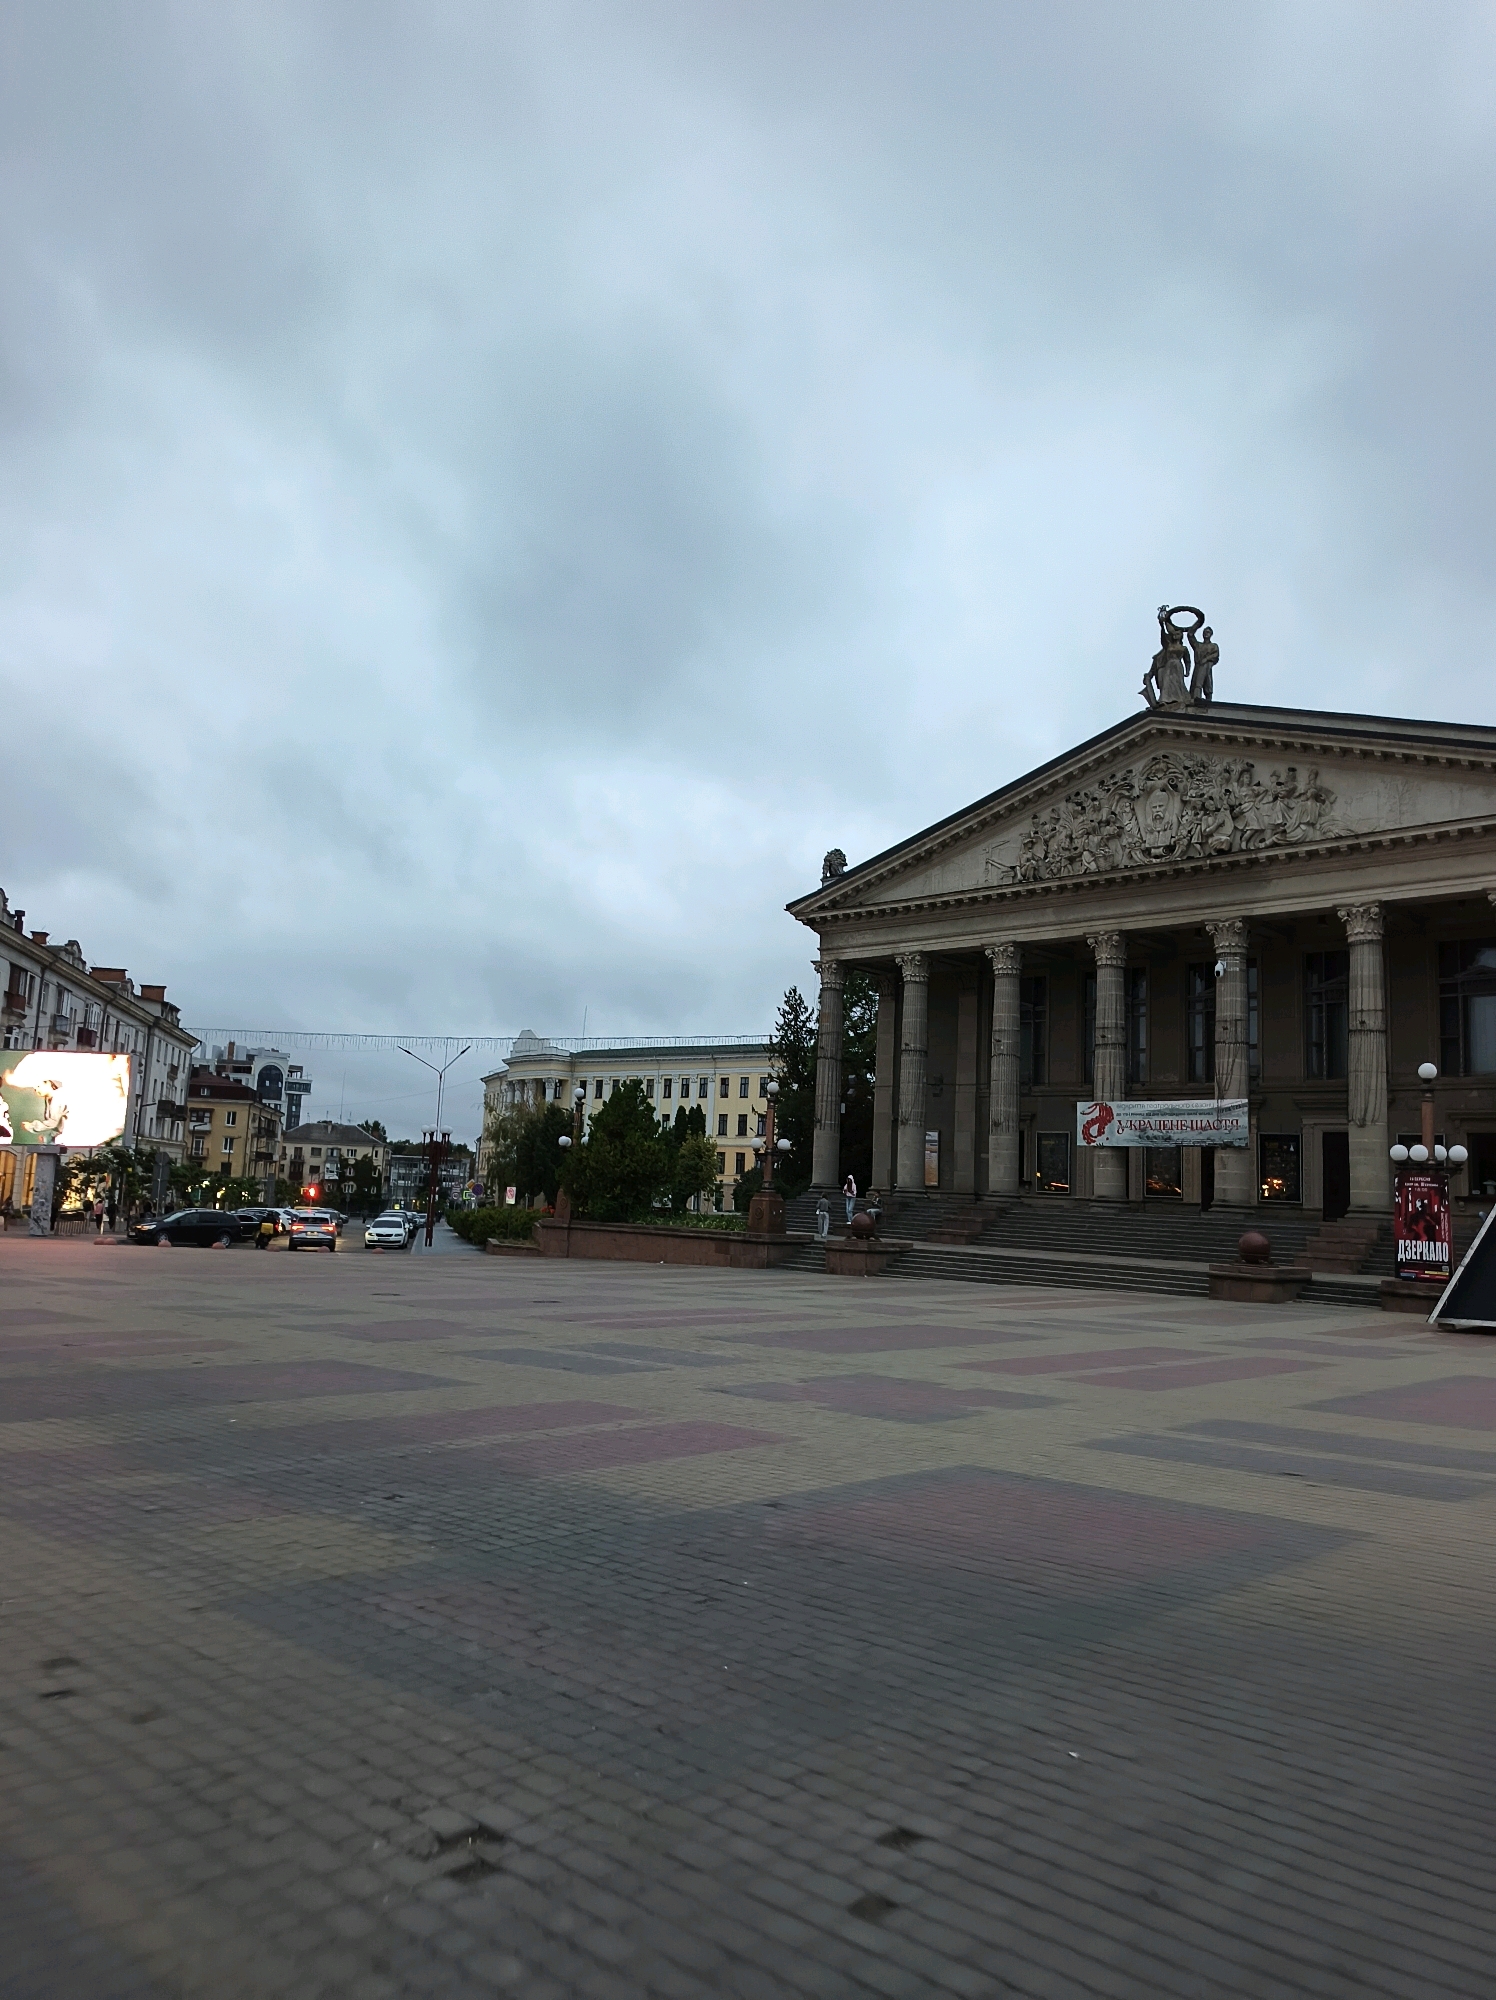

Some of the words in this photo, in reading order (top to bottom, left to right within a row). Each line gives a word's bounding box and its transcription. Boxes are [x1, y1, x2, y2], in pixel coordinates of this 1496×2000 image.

[1116, 1119, 1188, 1135] УКРАДЕНЕ
[1190, 1118, 1239, 1132] ЩАСТЯ
[1398, 1239, 1449, 1263] ДЗЕРКАЛО
